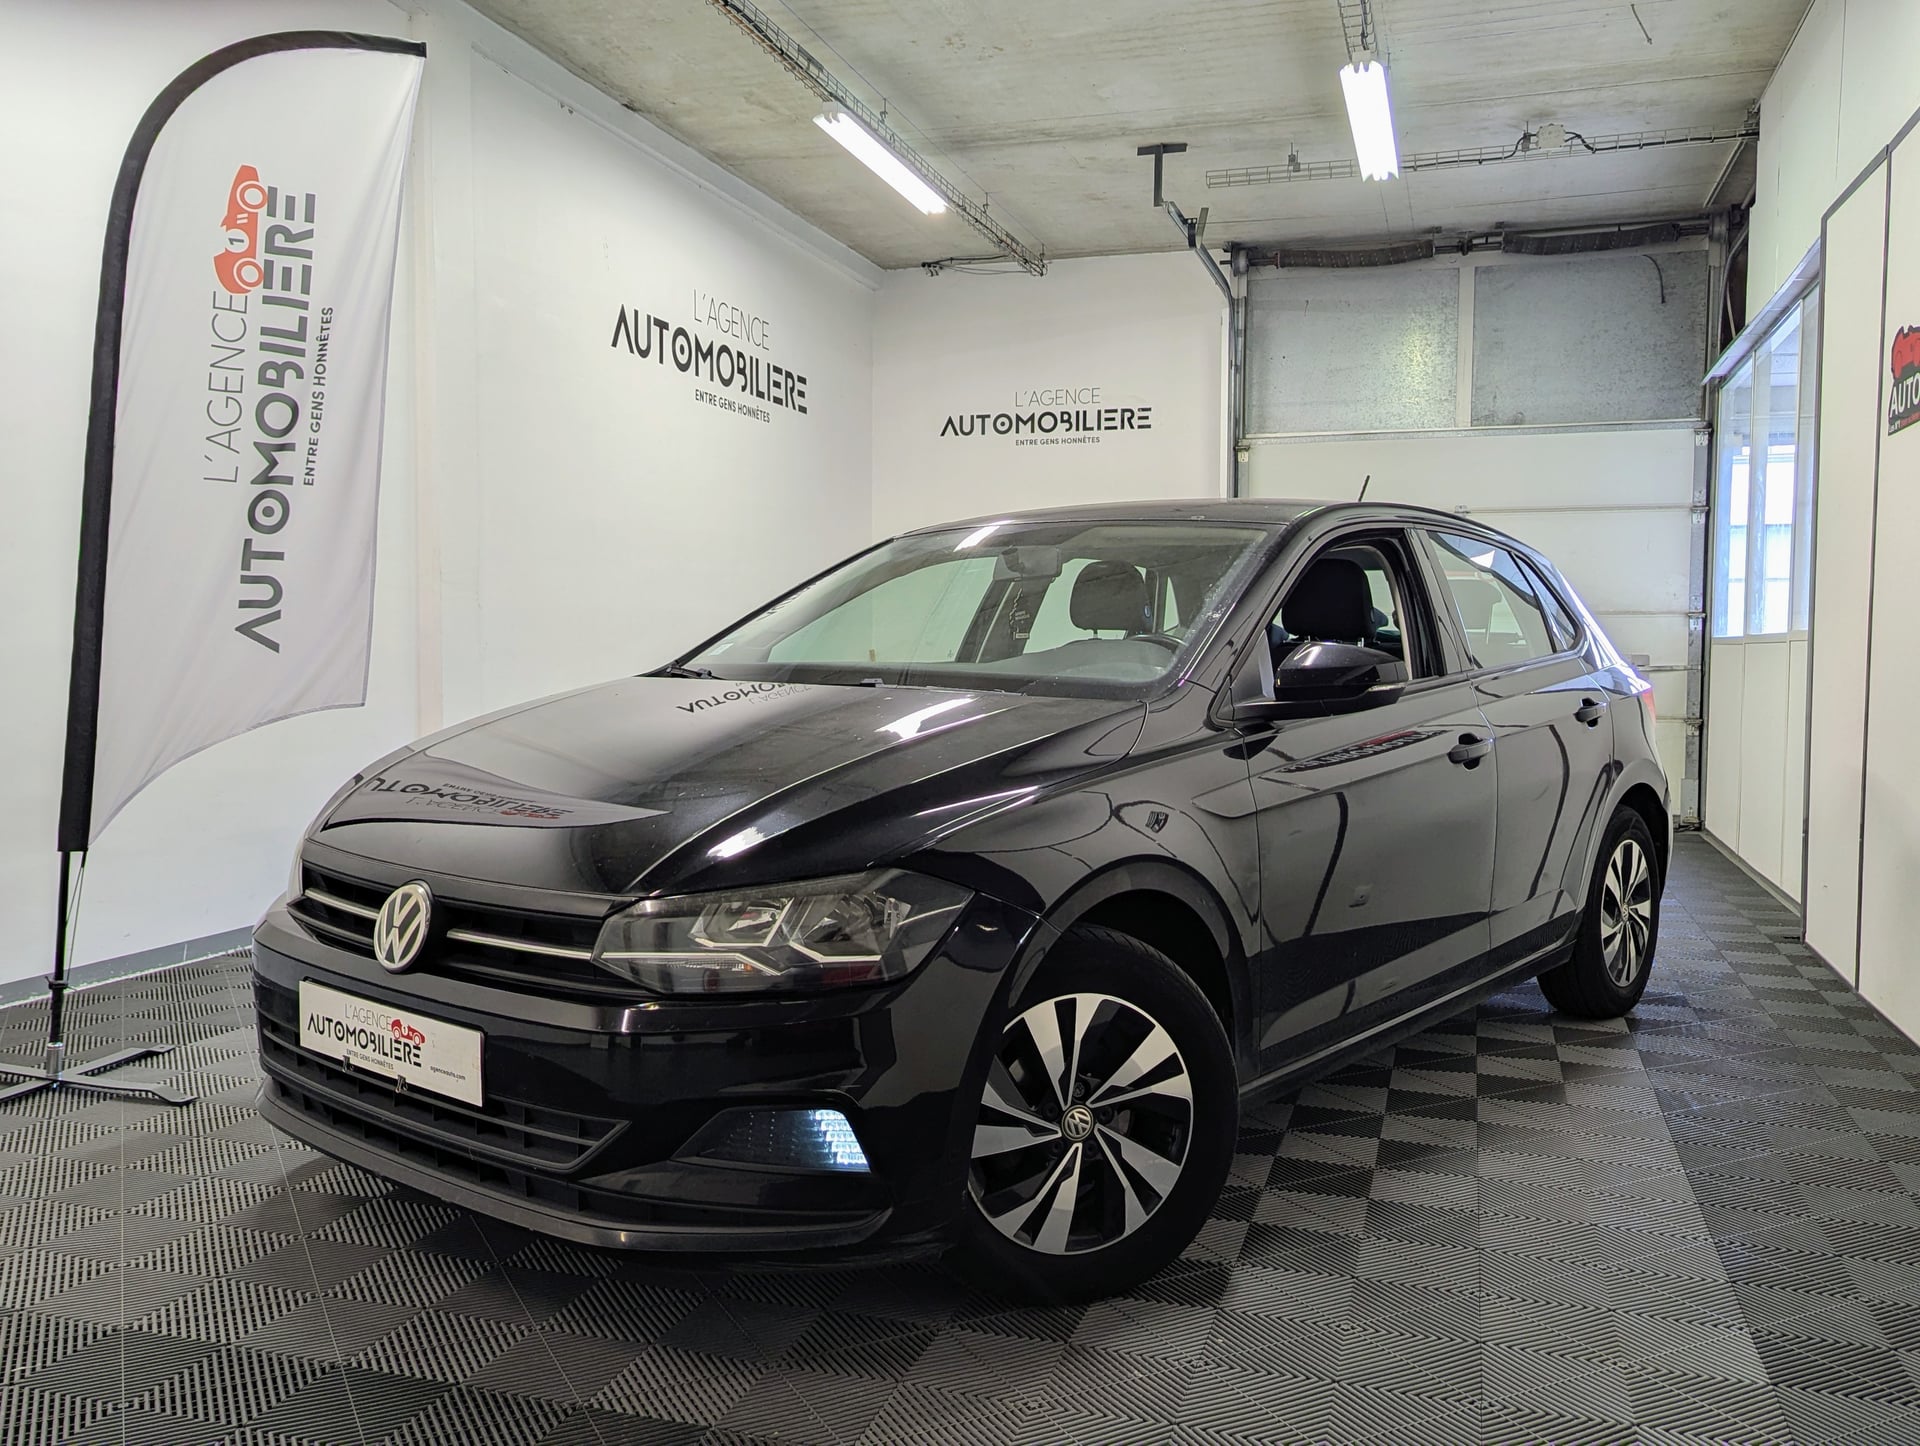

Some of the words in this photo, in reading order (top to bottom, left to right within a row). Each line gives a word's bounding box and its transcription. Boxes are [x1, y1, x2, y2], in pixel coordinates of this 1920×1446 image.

[693, 288, 770, 351] L'AGENCE
[316, 306, 334, 388] HONNÊTES
[611, 303, 808, 415] AUTOMOBILIERE
[203, 291, 248, 484] L'AGENCE
[695, 389, 717, 407] ENTRE
[718, 397, 737, 413] GENS
[1014, 388, 1101, 407] L'AGENCE
[235, 185, 316, 654] AUTOMOBILIERE
[310, 390, 326, 435] GENS
[940, 407, 1152, 437] AUTOMOBILIERE
[303, 439, 319, 487] ENTRE
[1015, 438, 1039, 446] ENTRE
[1039, 438, 1060, 446] GENS
[307, 1012, 422, 1068] AUTOMOBILIERE
[344, 1003, 392, 1032] L'AGENCE
[346, 1048, 359, 1059] ENTRE
